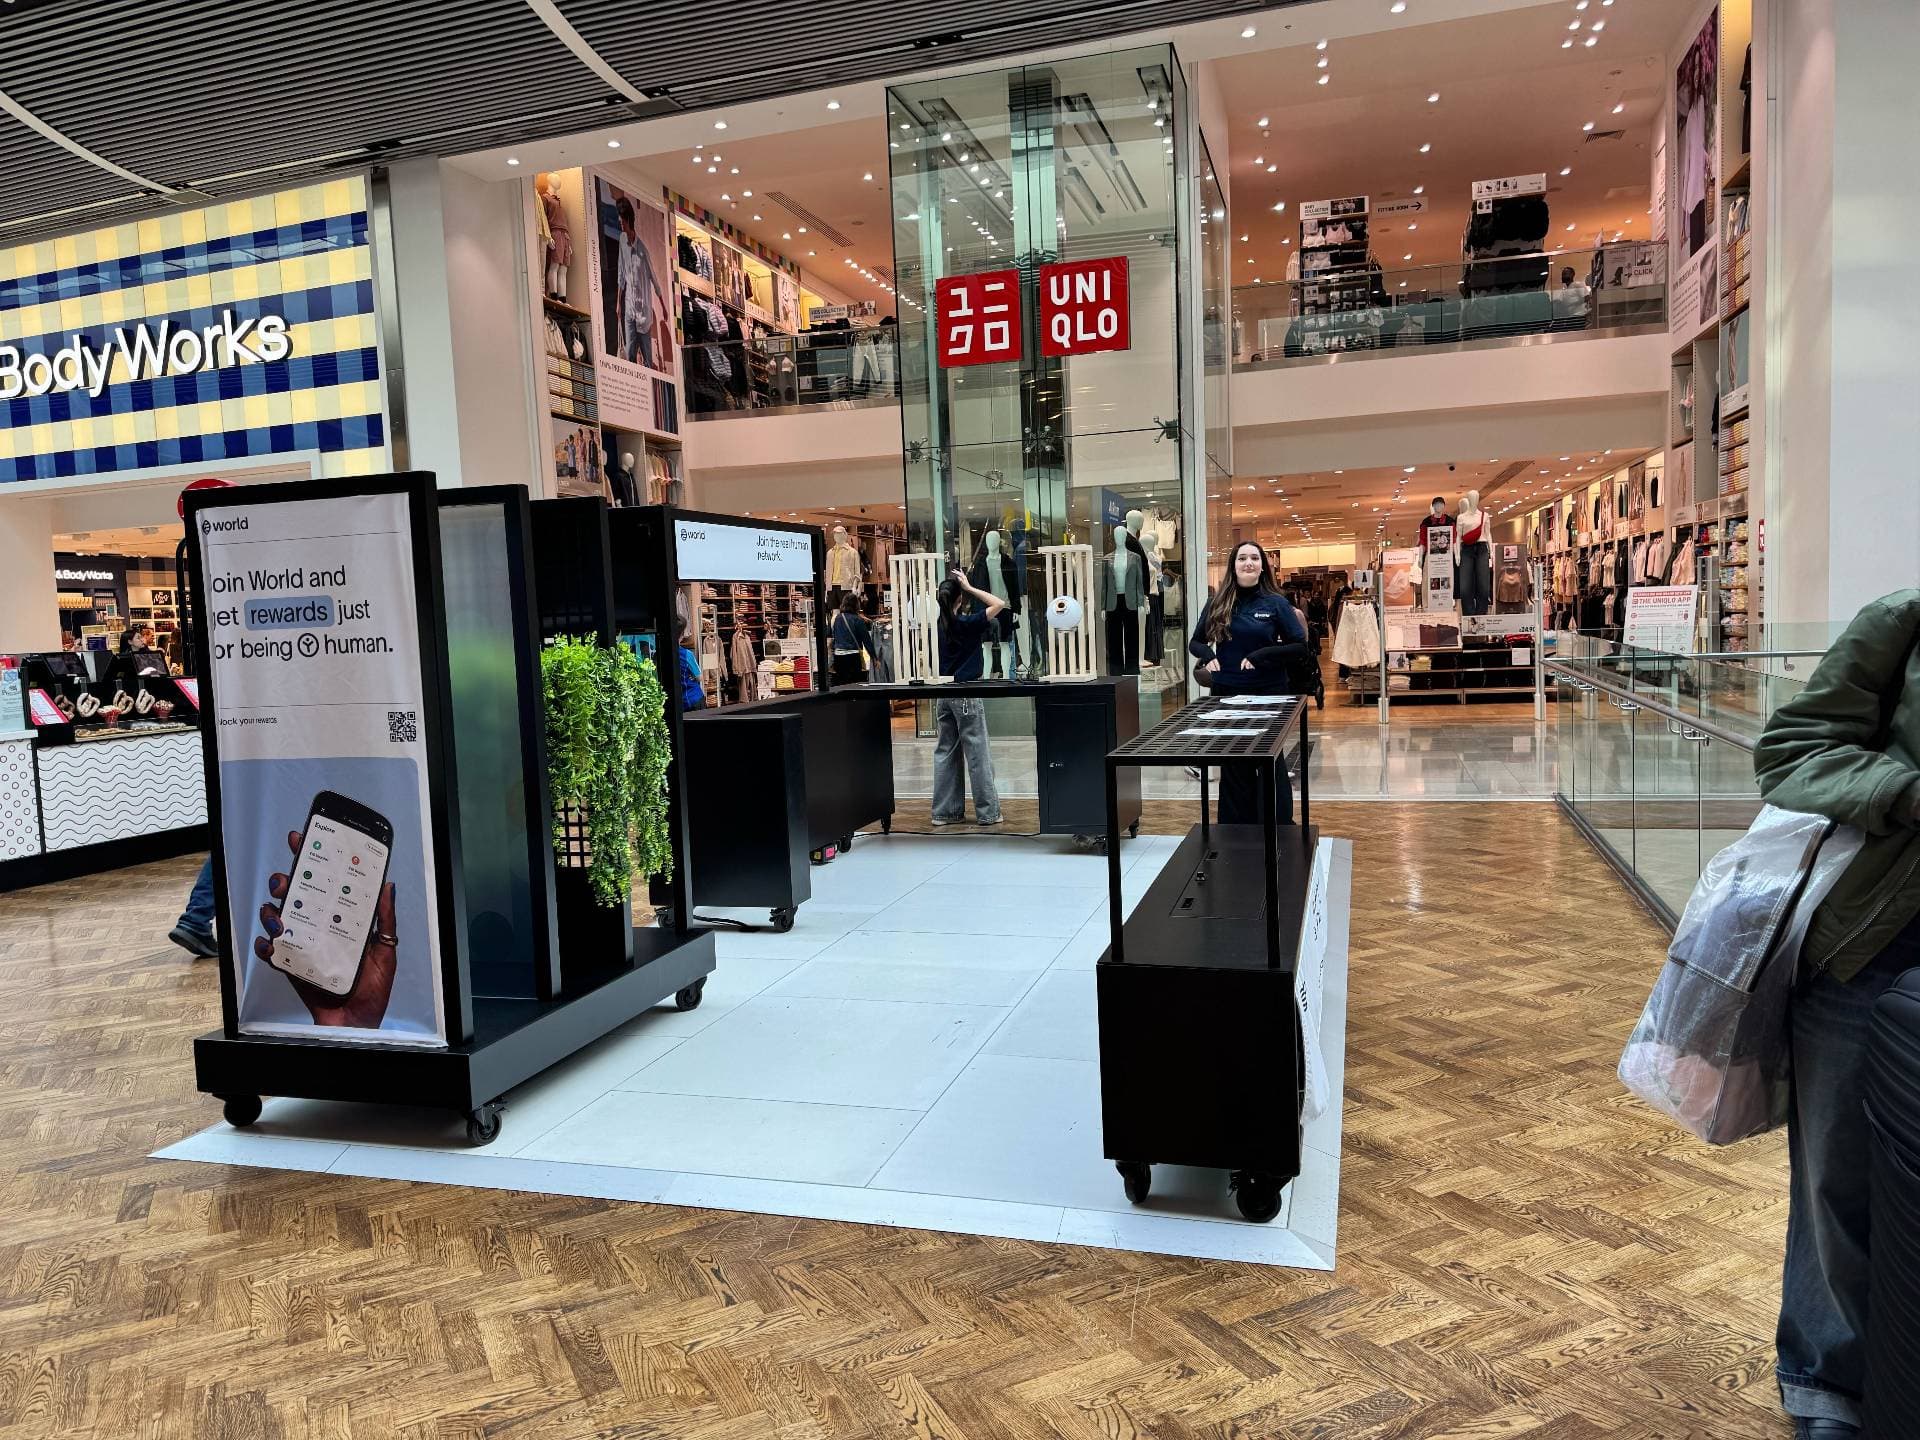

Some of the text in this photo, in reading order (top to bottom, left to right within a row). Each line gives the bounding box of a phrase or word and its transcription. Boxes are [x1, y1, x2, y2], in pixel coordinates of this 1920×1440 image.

[1049, 269, 1111, 306] UNI
[1050, 307, 1118, 349] QLO
[0, 309, 289, 399] Body Works
[213, 517, 249, 532] world
[757, 535, 769, 548] Join
[770, 535, 780, 548] the
[790, 538, 809, 550] human
[210, 564, 347, 593] oin World and
[250, 600, 329, 625] rewards
[337, 600, 371, 626] just
[1652, 597, 1677, 605] UNIQLO
[215, 633, 394, 662] or being human.
